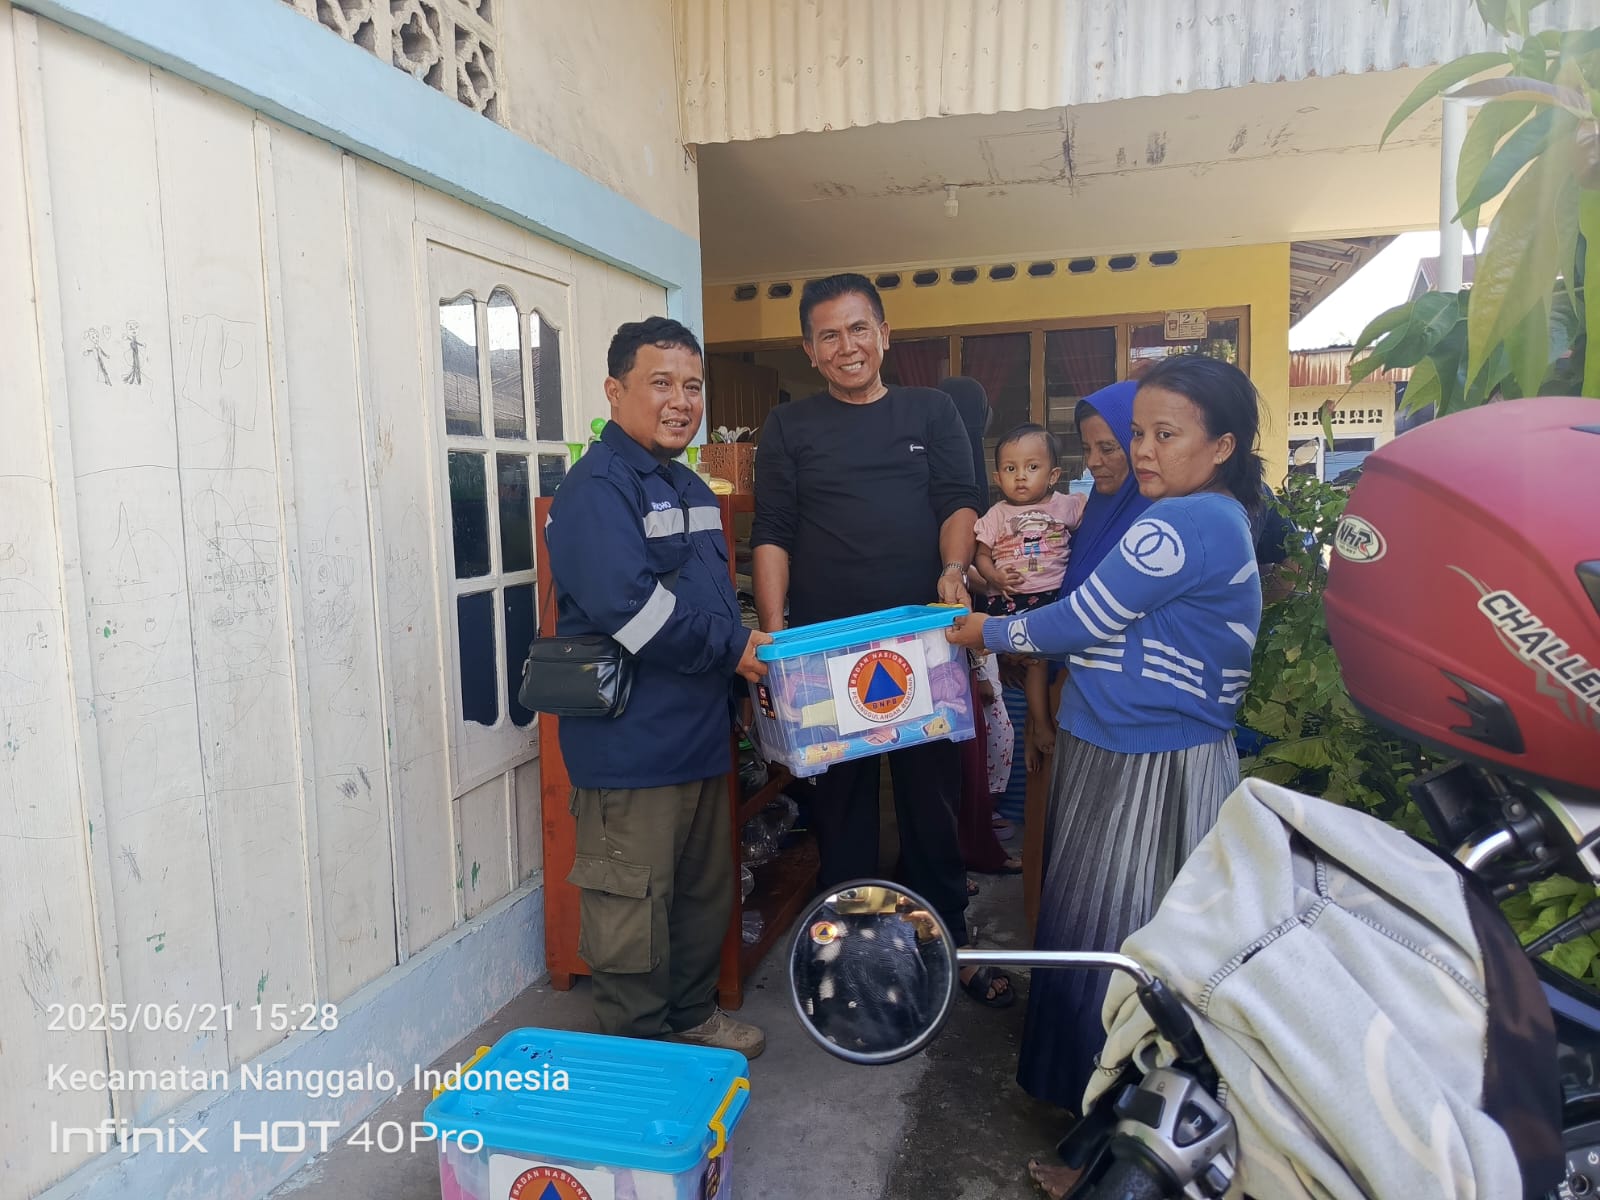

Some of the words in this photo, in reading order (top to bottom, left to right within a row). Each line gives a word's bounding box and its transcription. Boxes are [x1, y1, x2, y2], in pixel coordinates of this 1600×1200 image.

[850, 657, 870, 686] BADAN
[871, 651, 911, 674] NASIONAL
[872, 698, 897, 710] BNPB
[513, 1170, 540, 1195] BADAN
[544, 1169, 590, 1200] NASIONA
